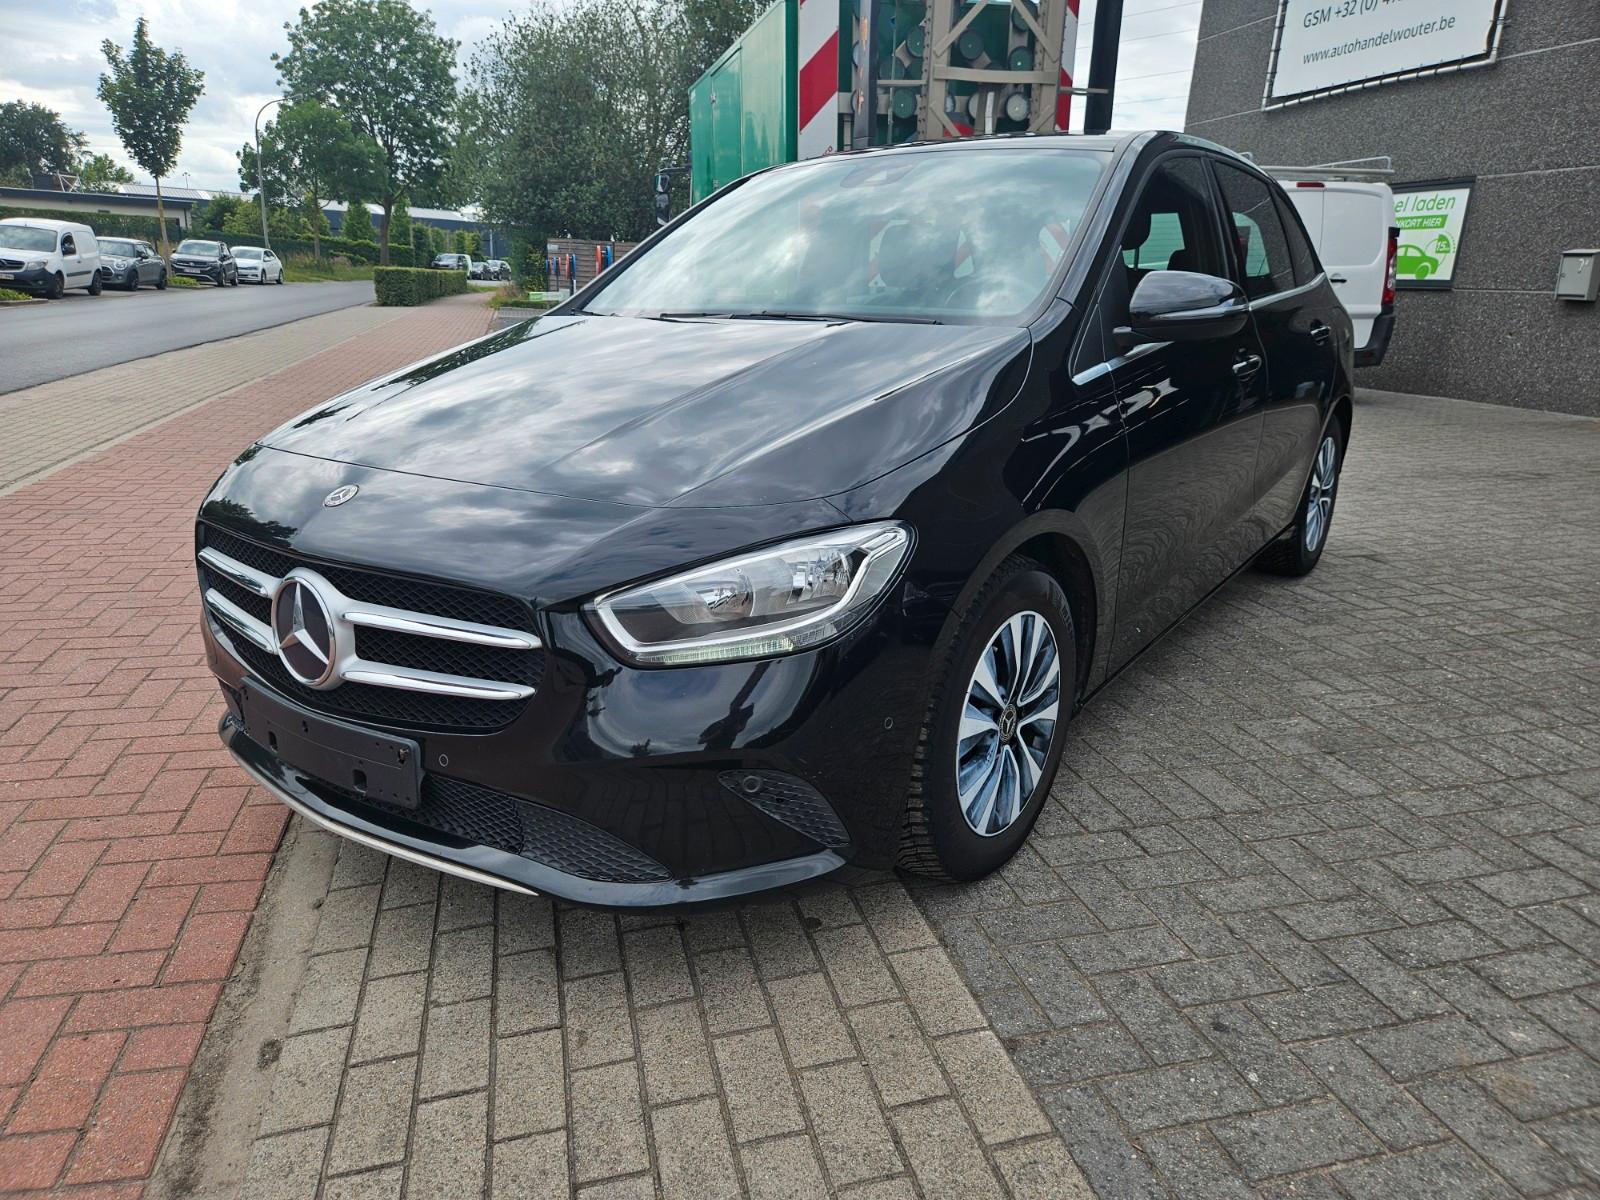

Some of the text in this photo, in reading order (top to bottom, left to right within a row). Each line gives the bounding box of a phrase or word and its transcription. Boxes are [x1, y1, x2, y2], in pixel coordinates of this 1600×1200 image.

[1304, 6, 1332, 28] GSM
[1335, 0, 1357, 18] +32
[1303, 16, 1456, 64] www.autohandelwouter.be
[1412, 193, 1456, 212] laden
